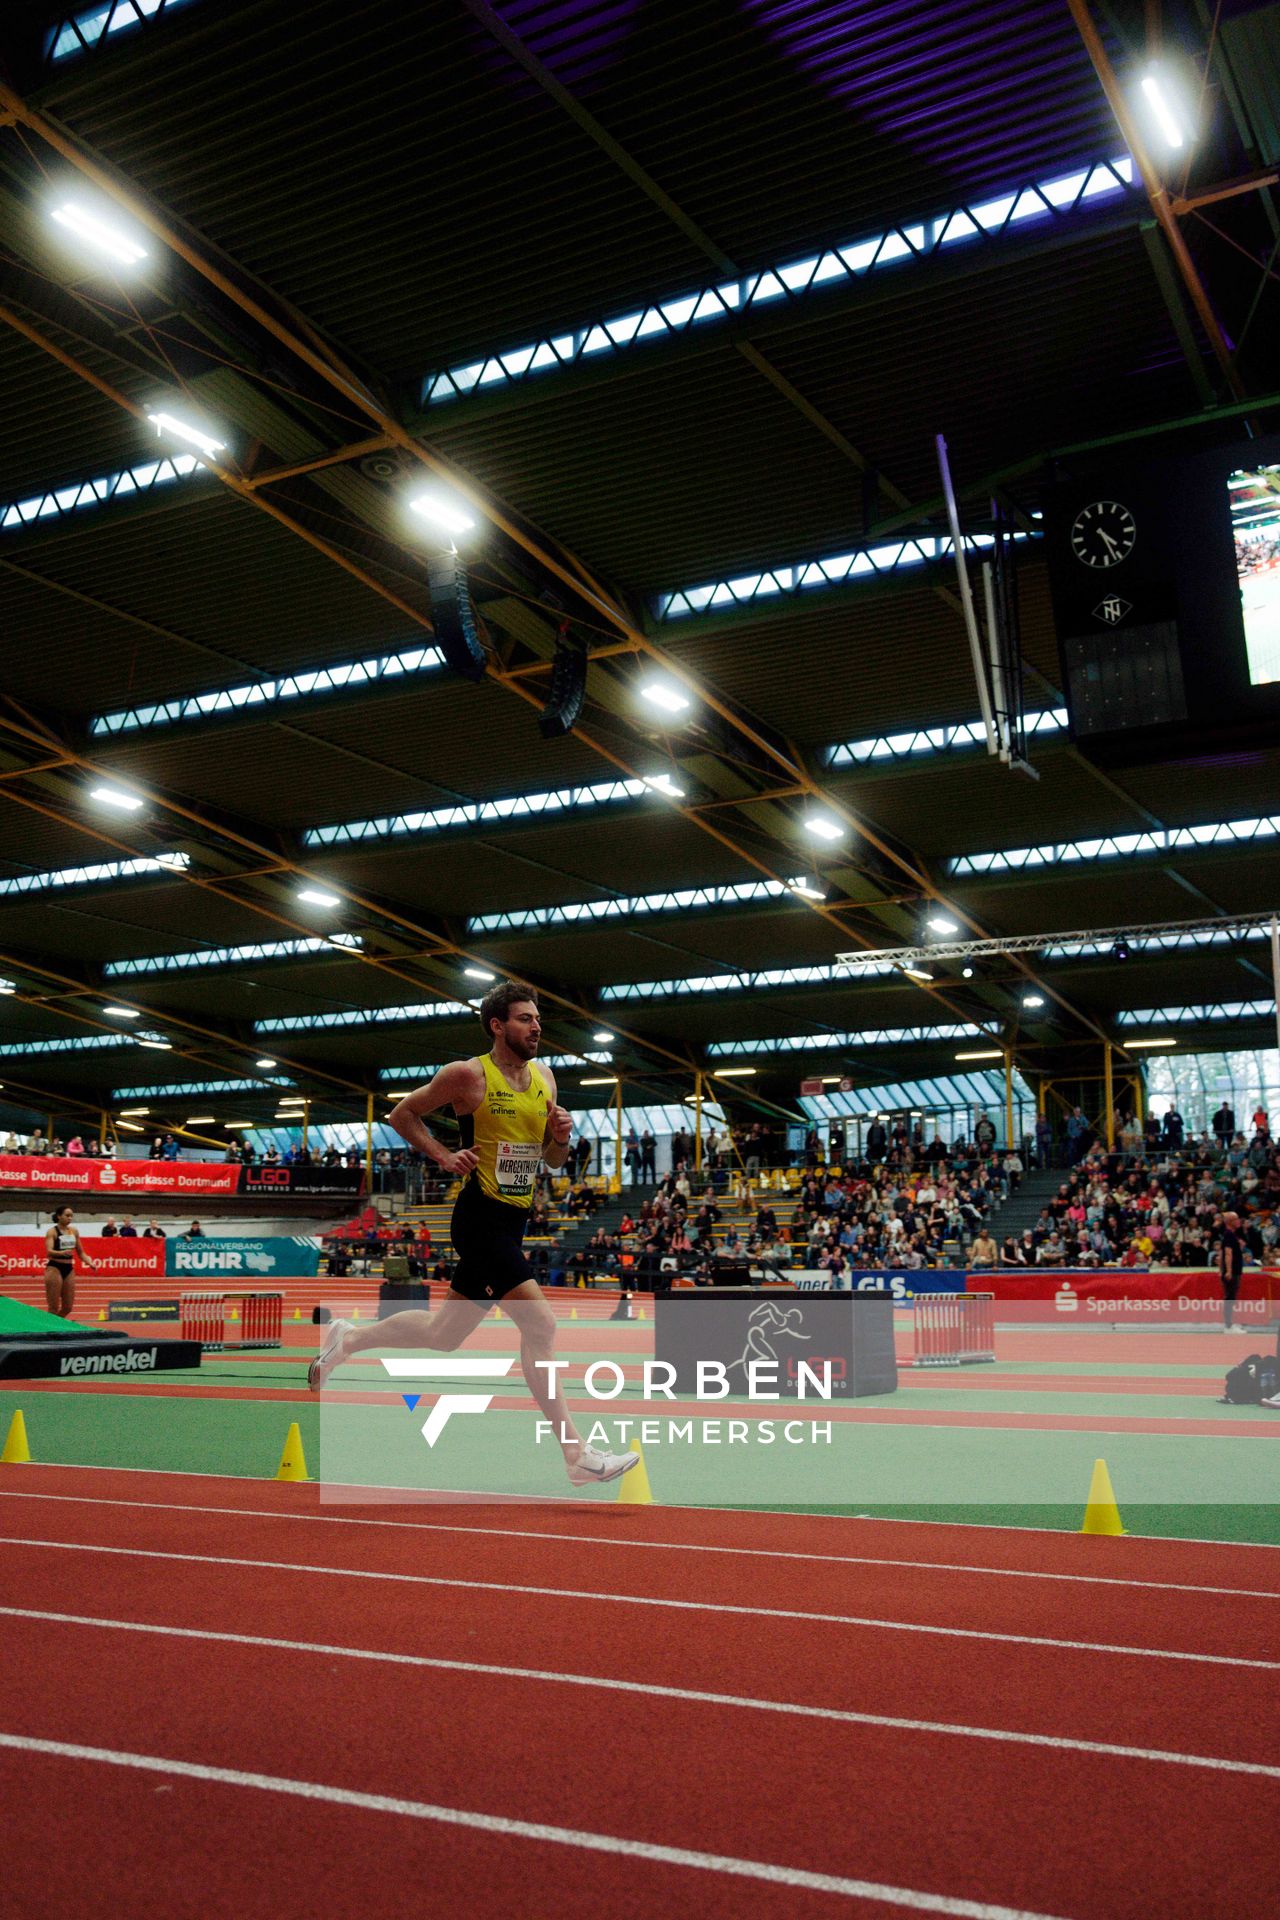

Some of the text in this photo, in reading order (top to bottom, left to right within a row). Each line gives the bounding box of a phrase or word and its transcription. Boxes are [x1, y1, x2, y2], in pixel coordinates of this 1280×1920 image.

[31, 1170, 89, 1184] Dortmund
[121, 1173, 231, 1188] Sparkasse Dortmund
[246, 1168, 290, 1185] LGO
[513, 1174, 529, 1185] 246
[175, 1242, 264, 1251] REGIONALVERBAND
[81, 1255, 158, 1269] Dortmund
[175, 1252, 243, 1269] RUHR
[1086, 1295, 1171, 1314] Sparkasse
[60, 1346, 158, 1375] vennekel
